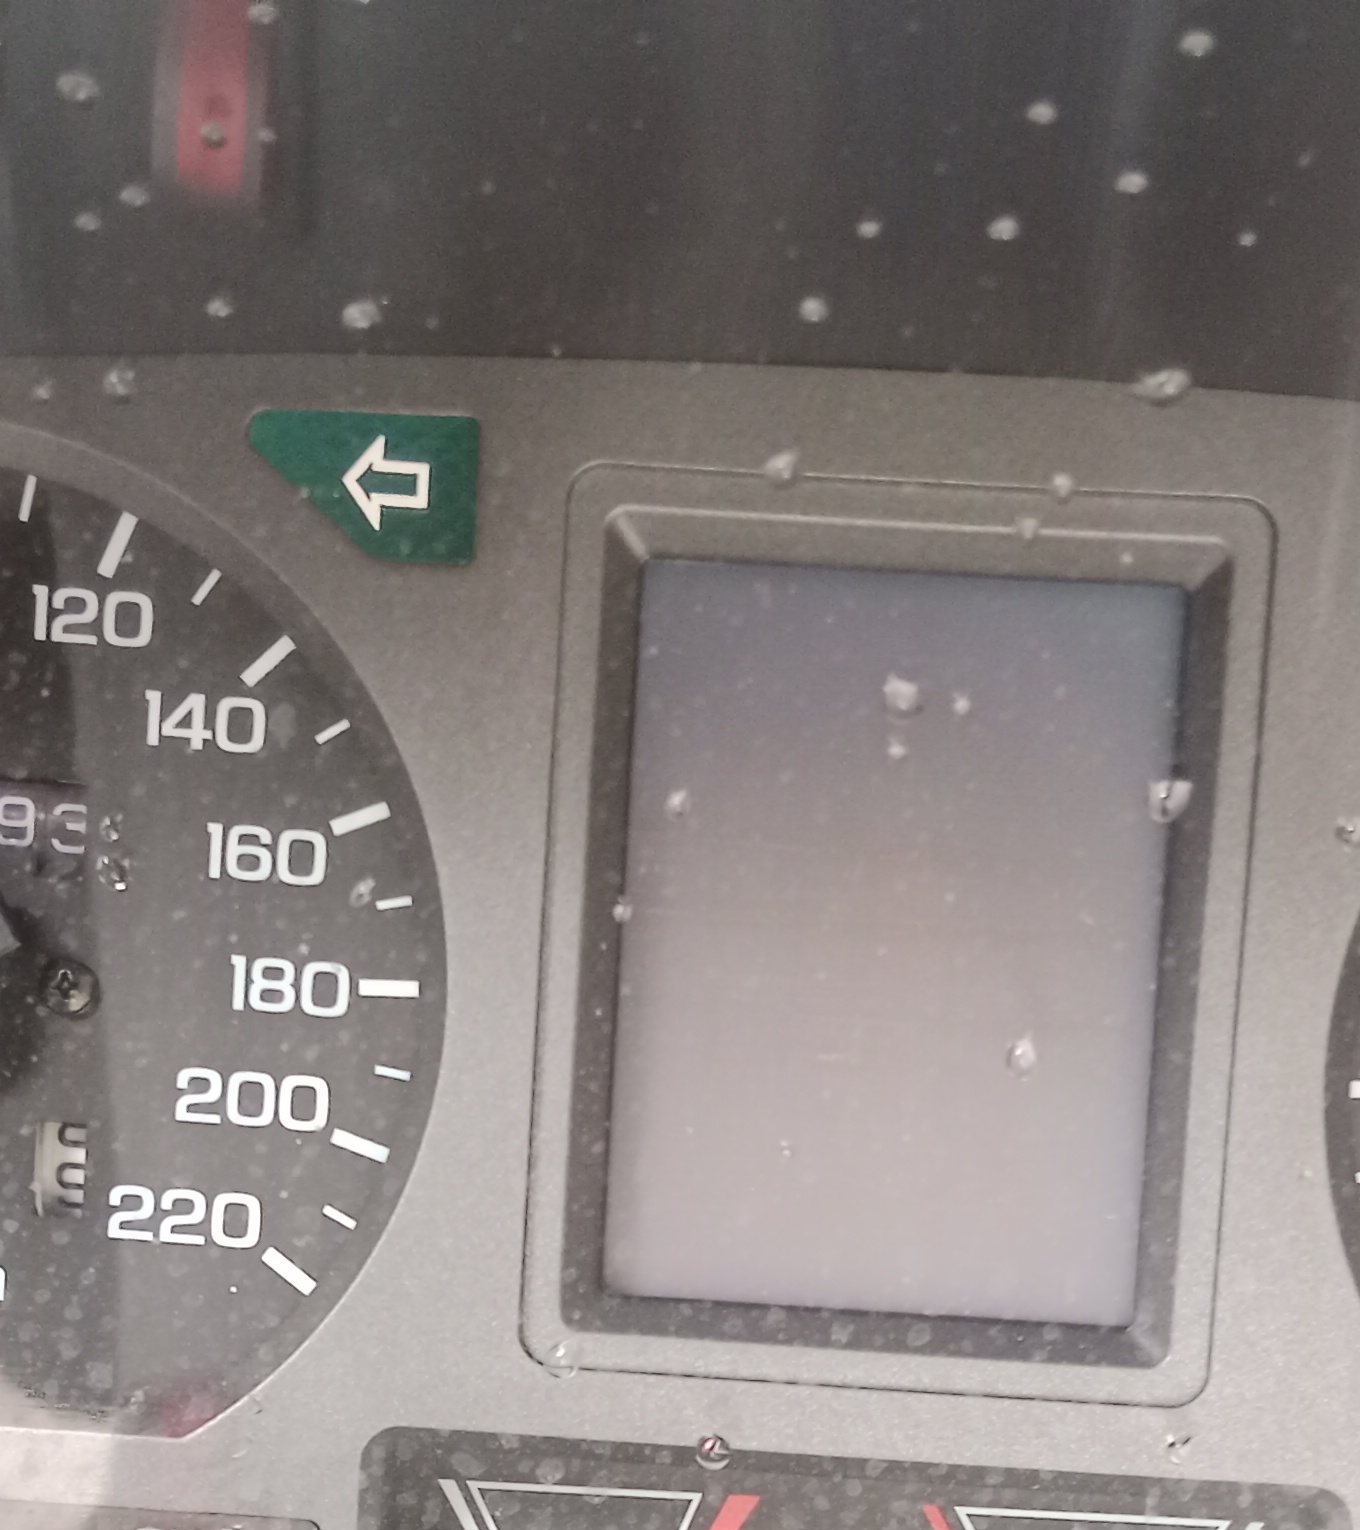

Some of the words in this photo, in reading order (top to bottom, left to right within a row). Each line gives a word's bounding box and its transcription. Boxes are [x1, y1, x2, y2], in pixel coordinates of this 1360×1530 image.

[33, 584, 154, 648] 120
[144, 690, 266, 754] 140
[206, 822, 327, 886] 160
[230, 954, 350, 1018] 180
[174, 1068, 330, 1133] 200
[107, 1185, 262, 1250] 220
